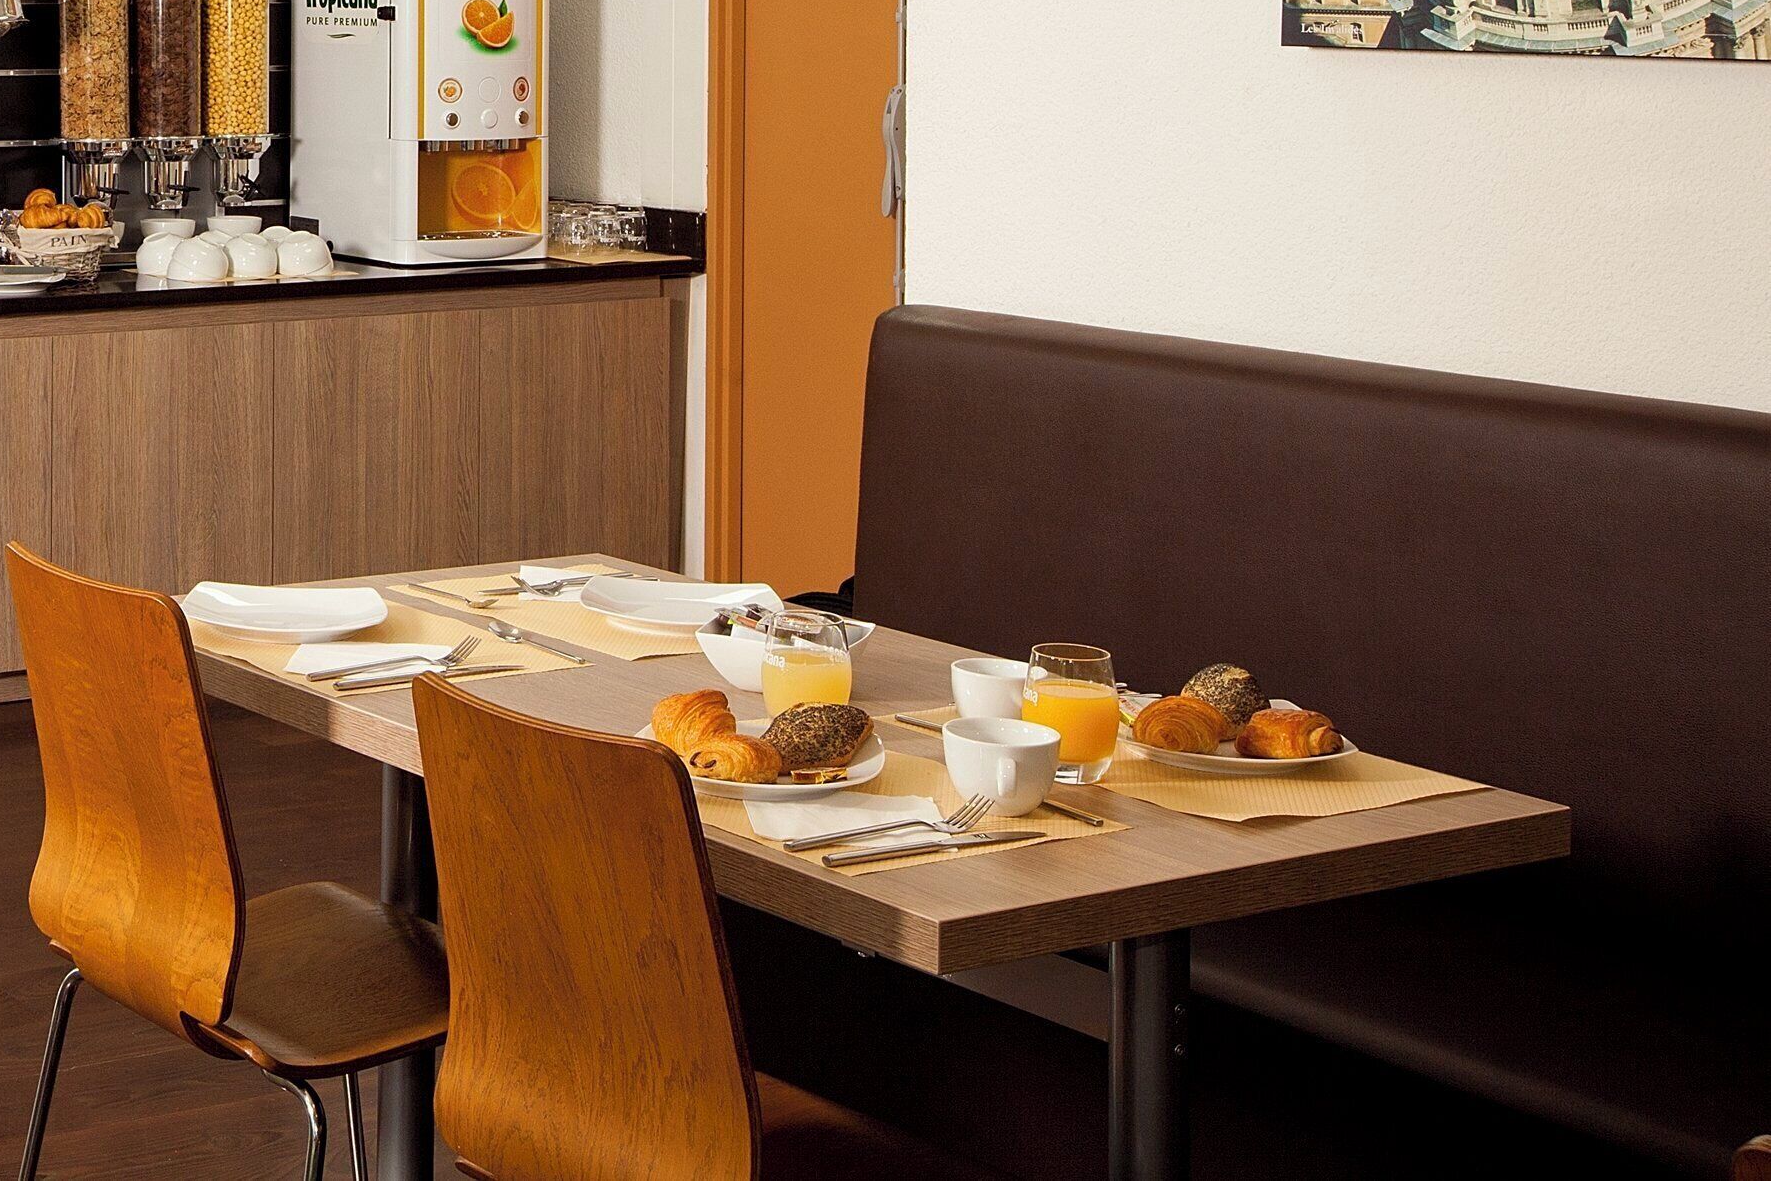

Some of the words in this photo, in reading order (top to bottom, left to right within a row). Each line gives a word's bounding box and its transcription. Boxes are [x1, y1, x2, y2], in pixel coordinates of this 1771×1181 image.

[306, 16, 329, 25] PURE
[333, 18, 378, 27] PREMIUM
[51, 234, 89, 248] PAIN
